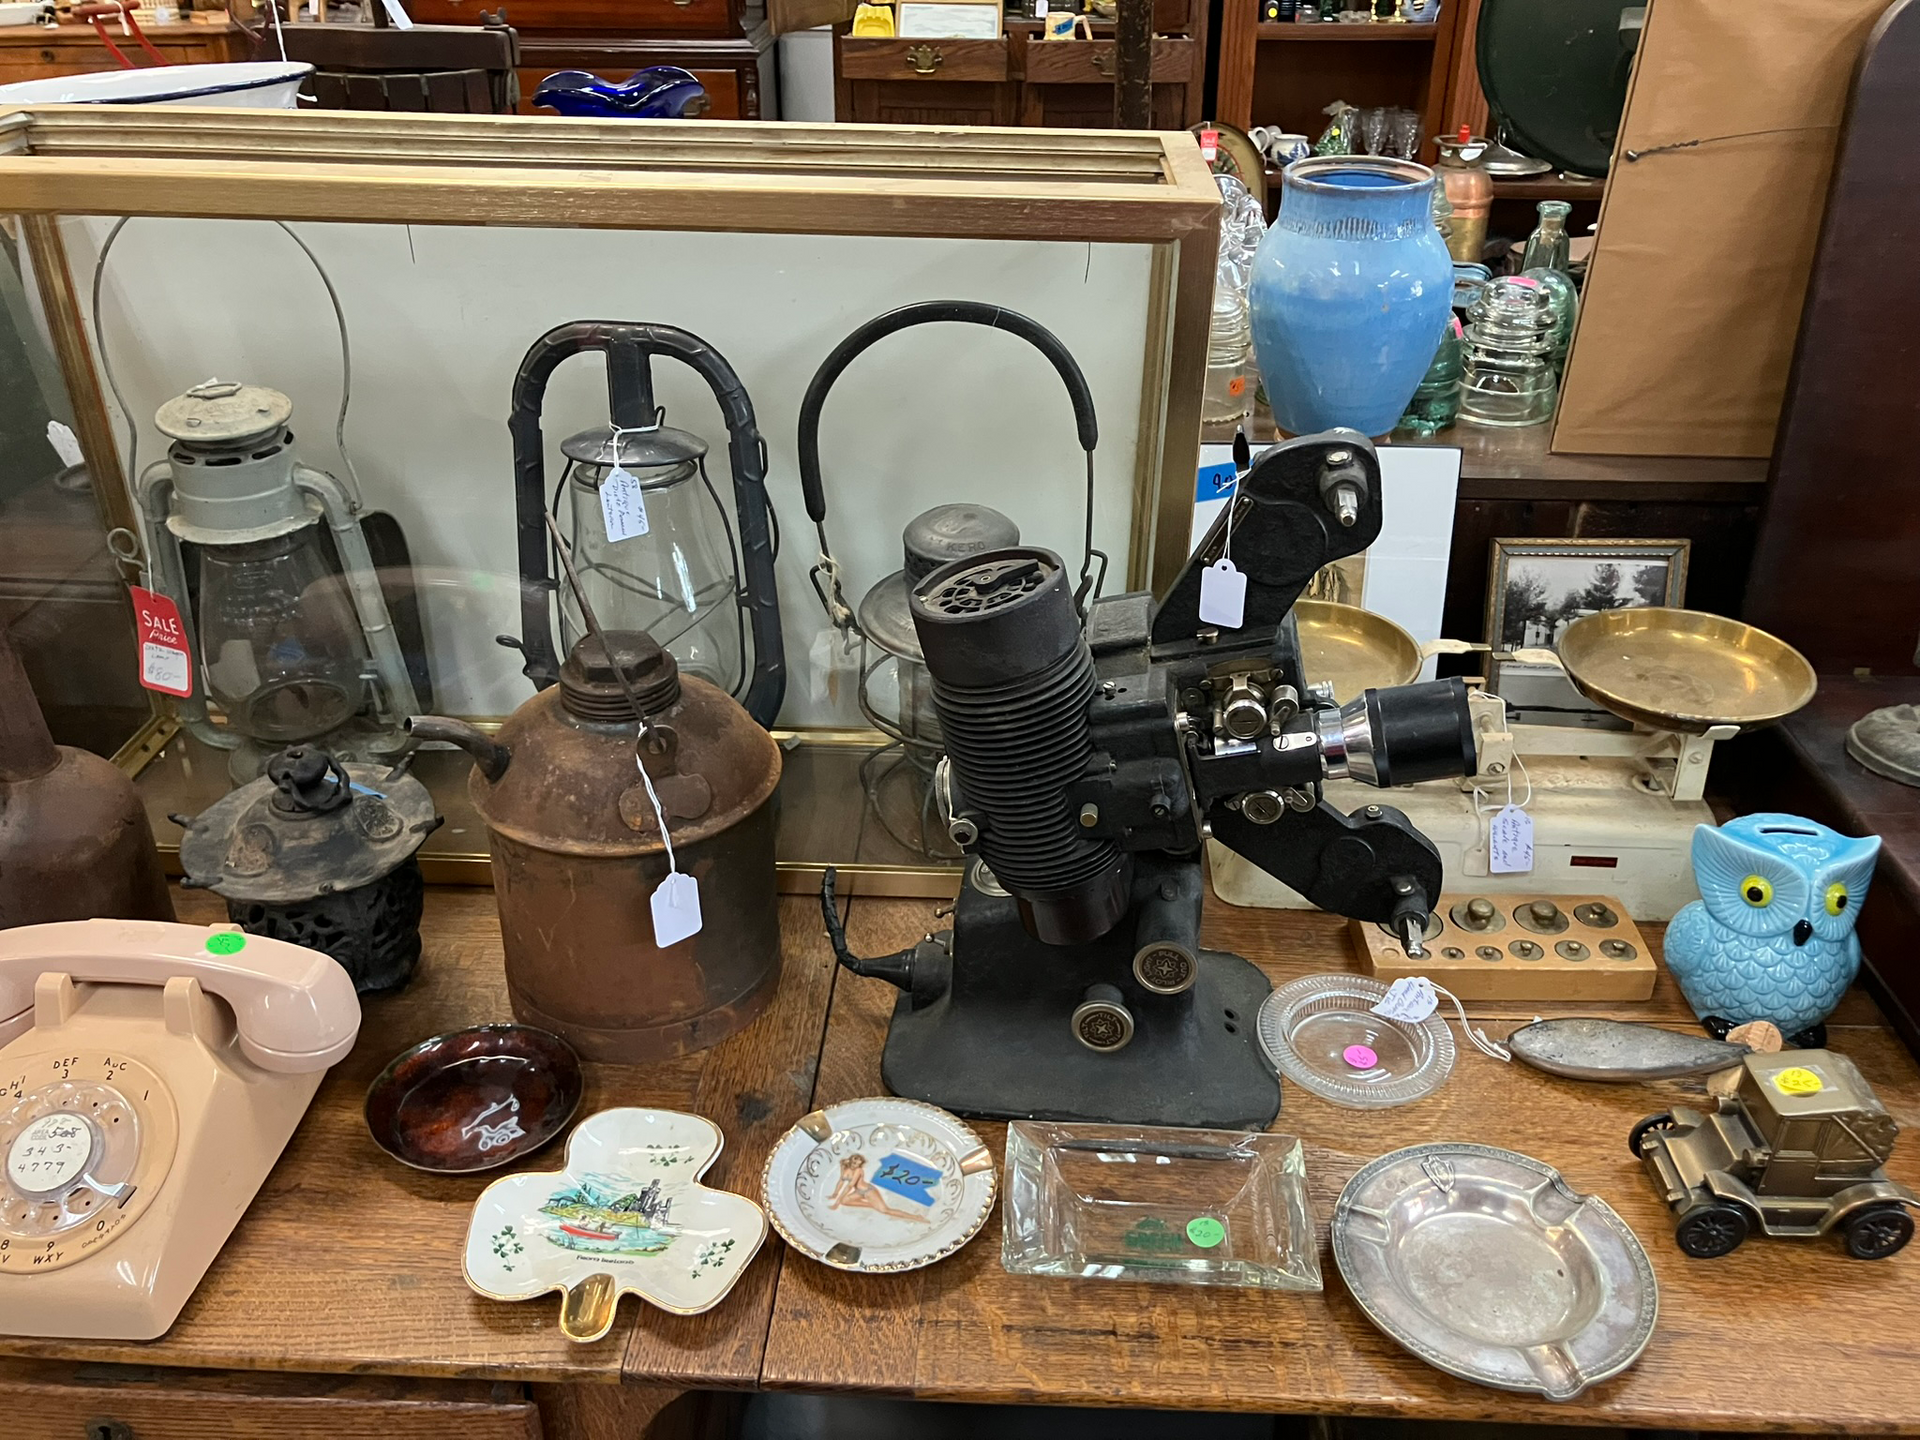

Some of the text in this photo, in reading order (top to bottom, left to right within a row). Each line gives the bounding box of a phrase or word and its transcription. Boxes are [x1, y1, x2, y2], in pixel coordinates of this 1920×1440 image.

[946, 541, 986, 553] KERO
[142, 609, 180, 635] SALE
[149, 629, 178, 645] Price
[1158, 950, 1180, 962] PULL
[1179, 961, 1188, 980] OUT
[1099, 1012, 1118, 1022] TILT
[53, 1057, 79, 1069] DEF
[62, 1069, 69, 1079] 3
[106, 1070, 114, 1080] 2
[14, 1090, 22, 1098] 4
[0, 1239, 10, 1250] 8
[46, 1241, 55, 1252] 9
[33, 1251, 64, 1265] WXY
